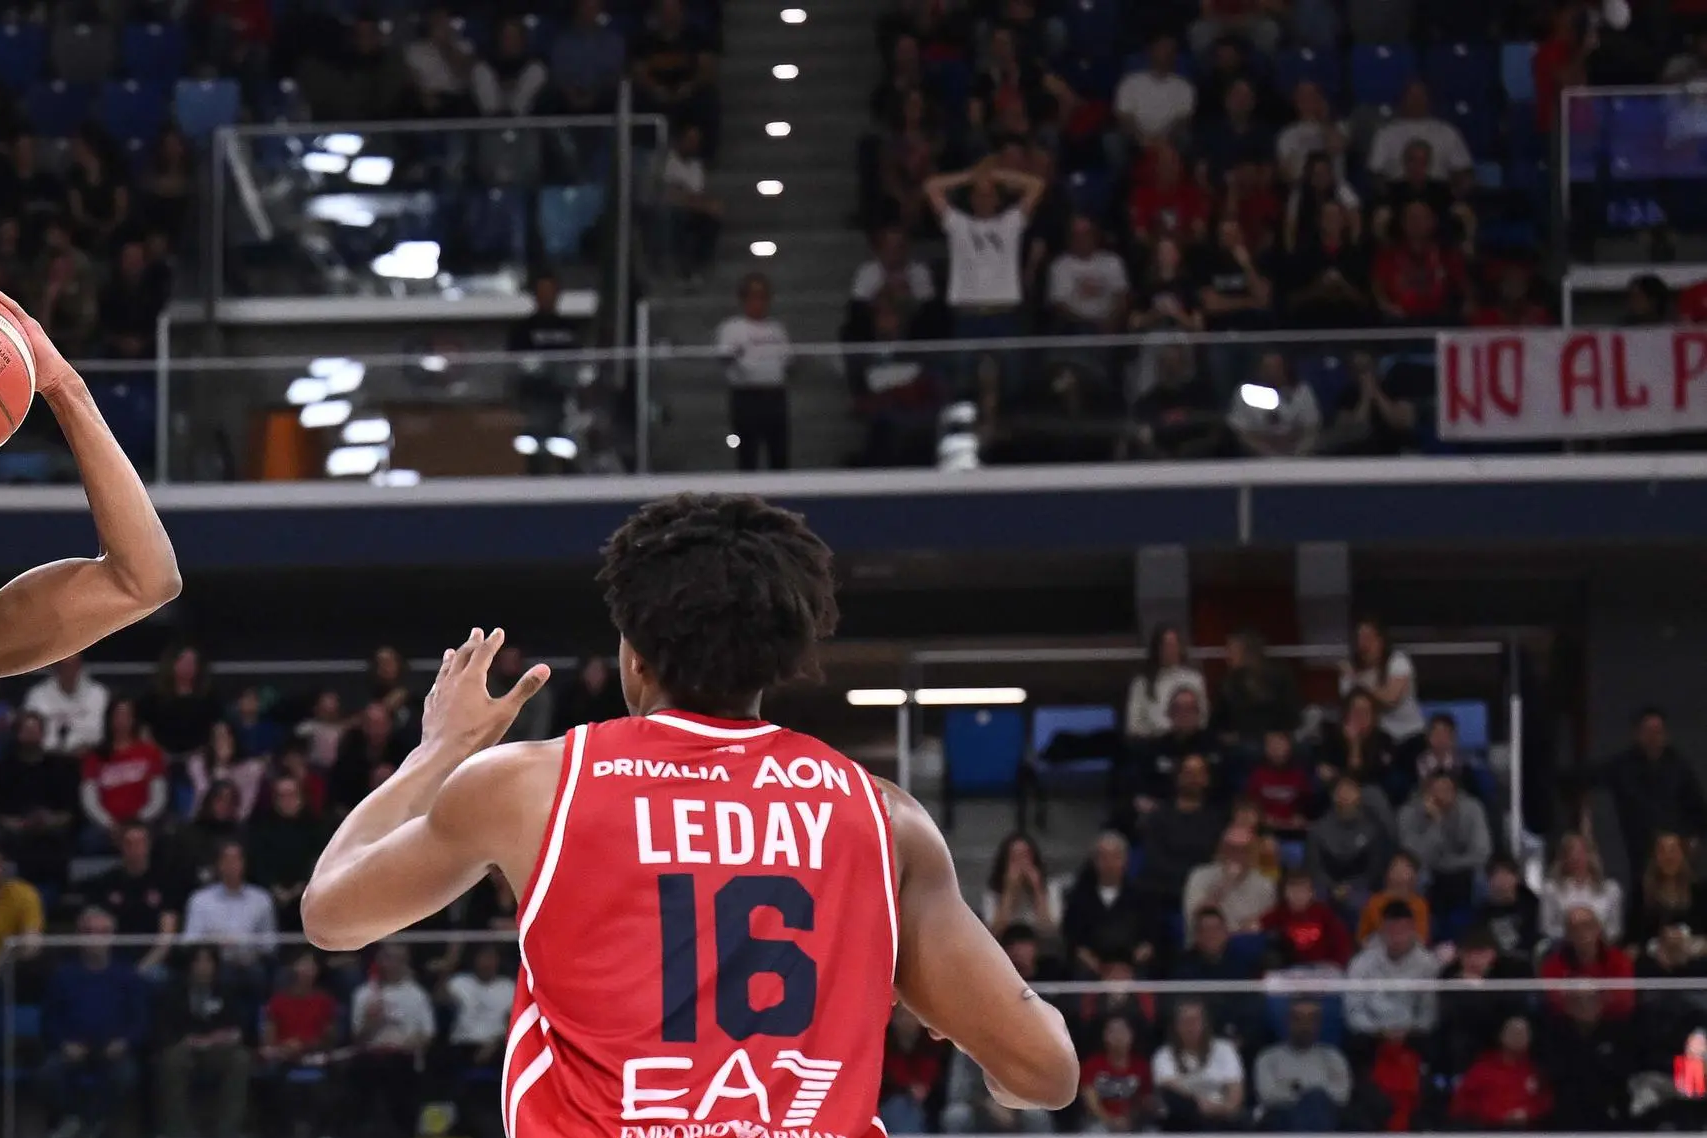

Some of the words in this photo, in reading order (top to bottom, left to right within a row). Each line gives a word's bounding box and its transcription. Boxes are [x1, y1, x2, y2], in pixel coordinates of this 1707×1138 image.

[1446, 336, 1524, 425] NO
[1559, 333, 1649, 417] AL
[592, 758, 730, 782] DRIVALIA
[752, 755, 852, 797] AON
[634, 796, 834, 870] LEDAY
[657, 873, 818, 1042] 16
[620, 1048, 844, 1128] EA7
